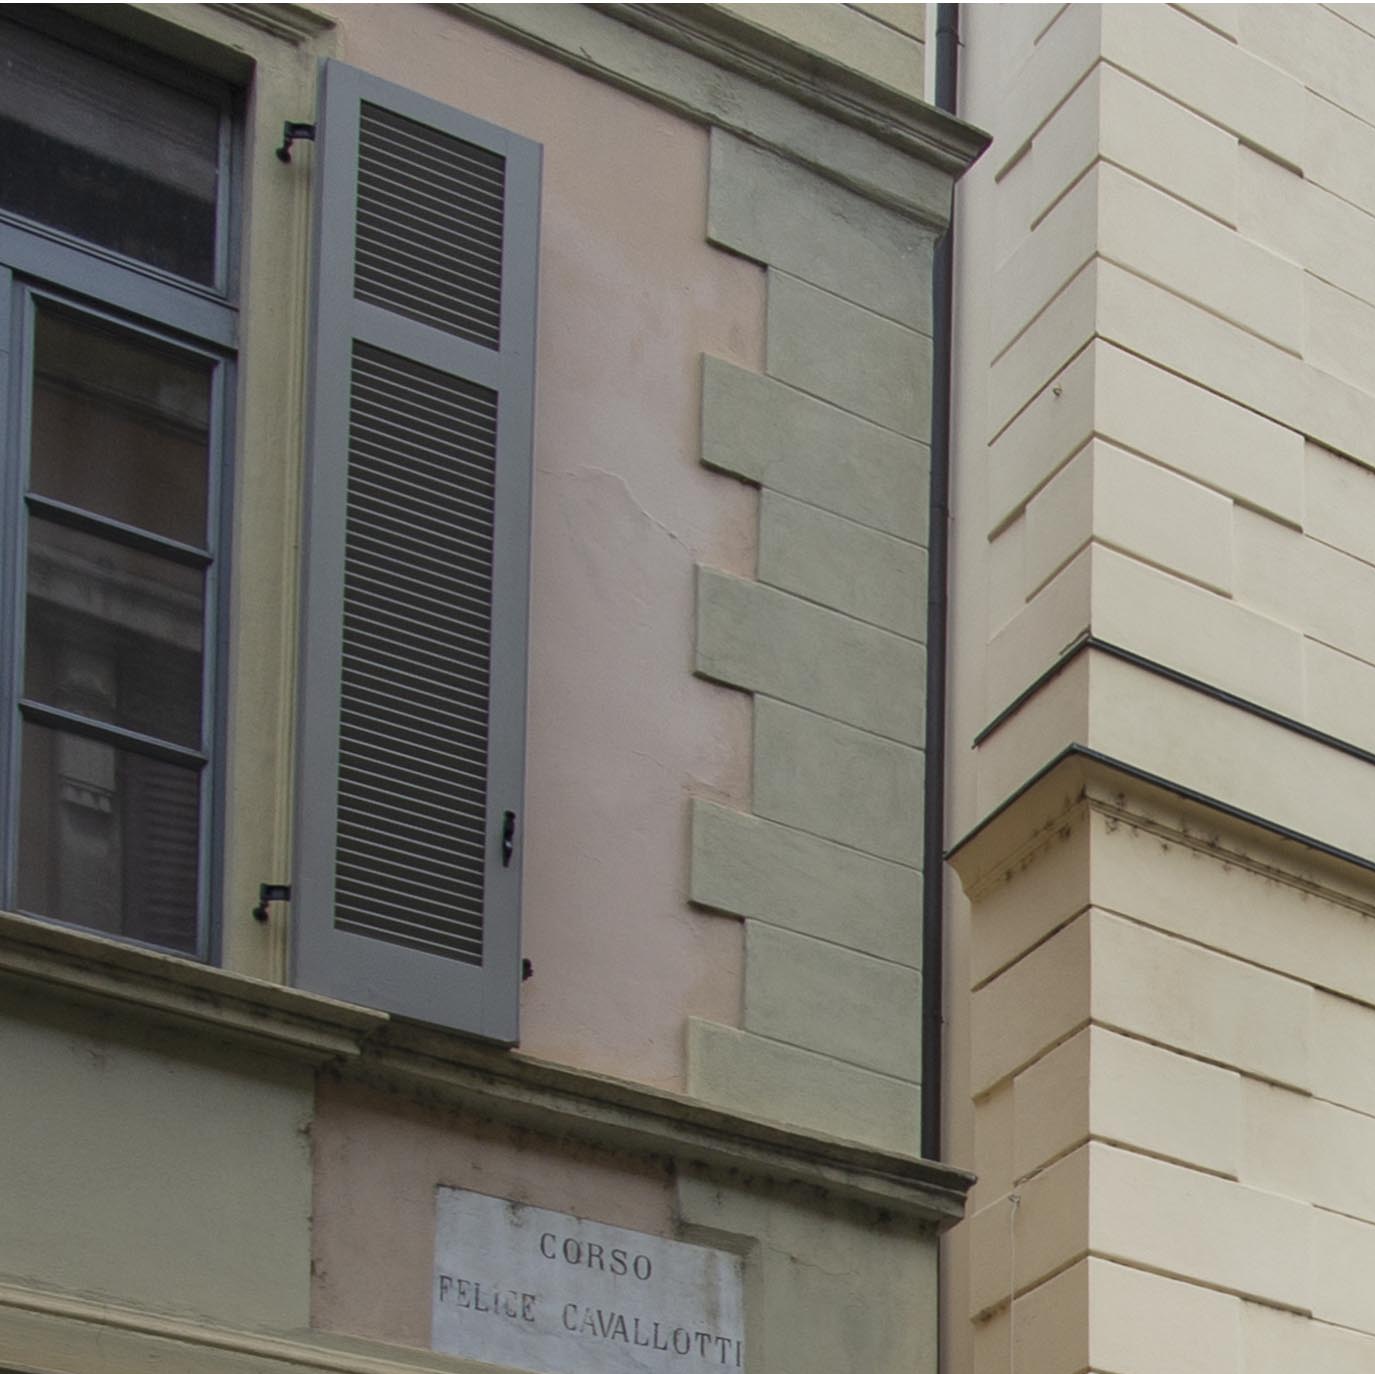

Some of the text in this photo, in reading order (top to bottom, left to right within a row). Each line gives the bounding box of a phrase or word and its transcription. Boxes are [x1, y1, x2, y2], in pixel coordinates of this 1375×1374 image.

[539, 1232, 652, 1280] CORSO
[438, 1275, 742, 1367] FELICE CAVALLOTTI
